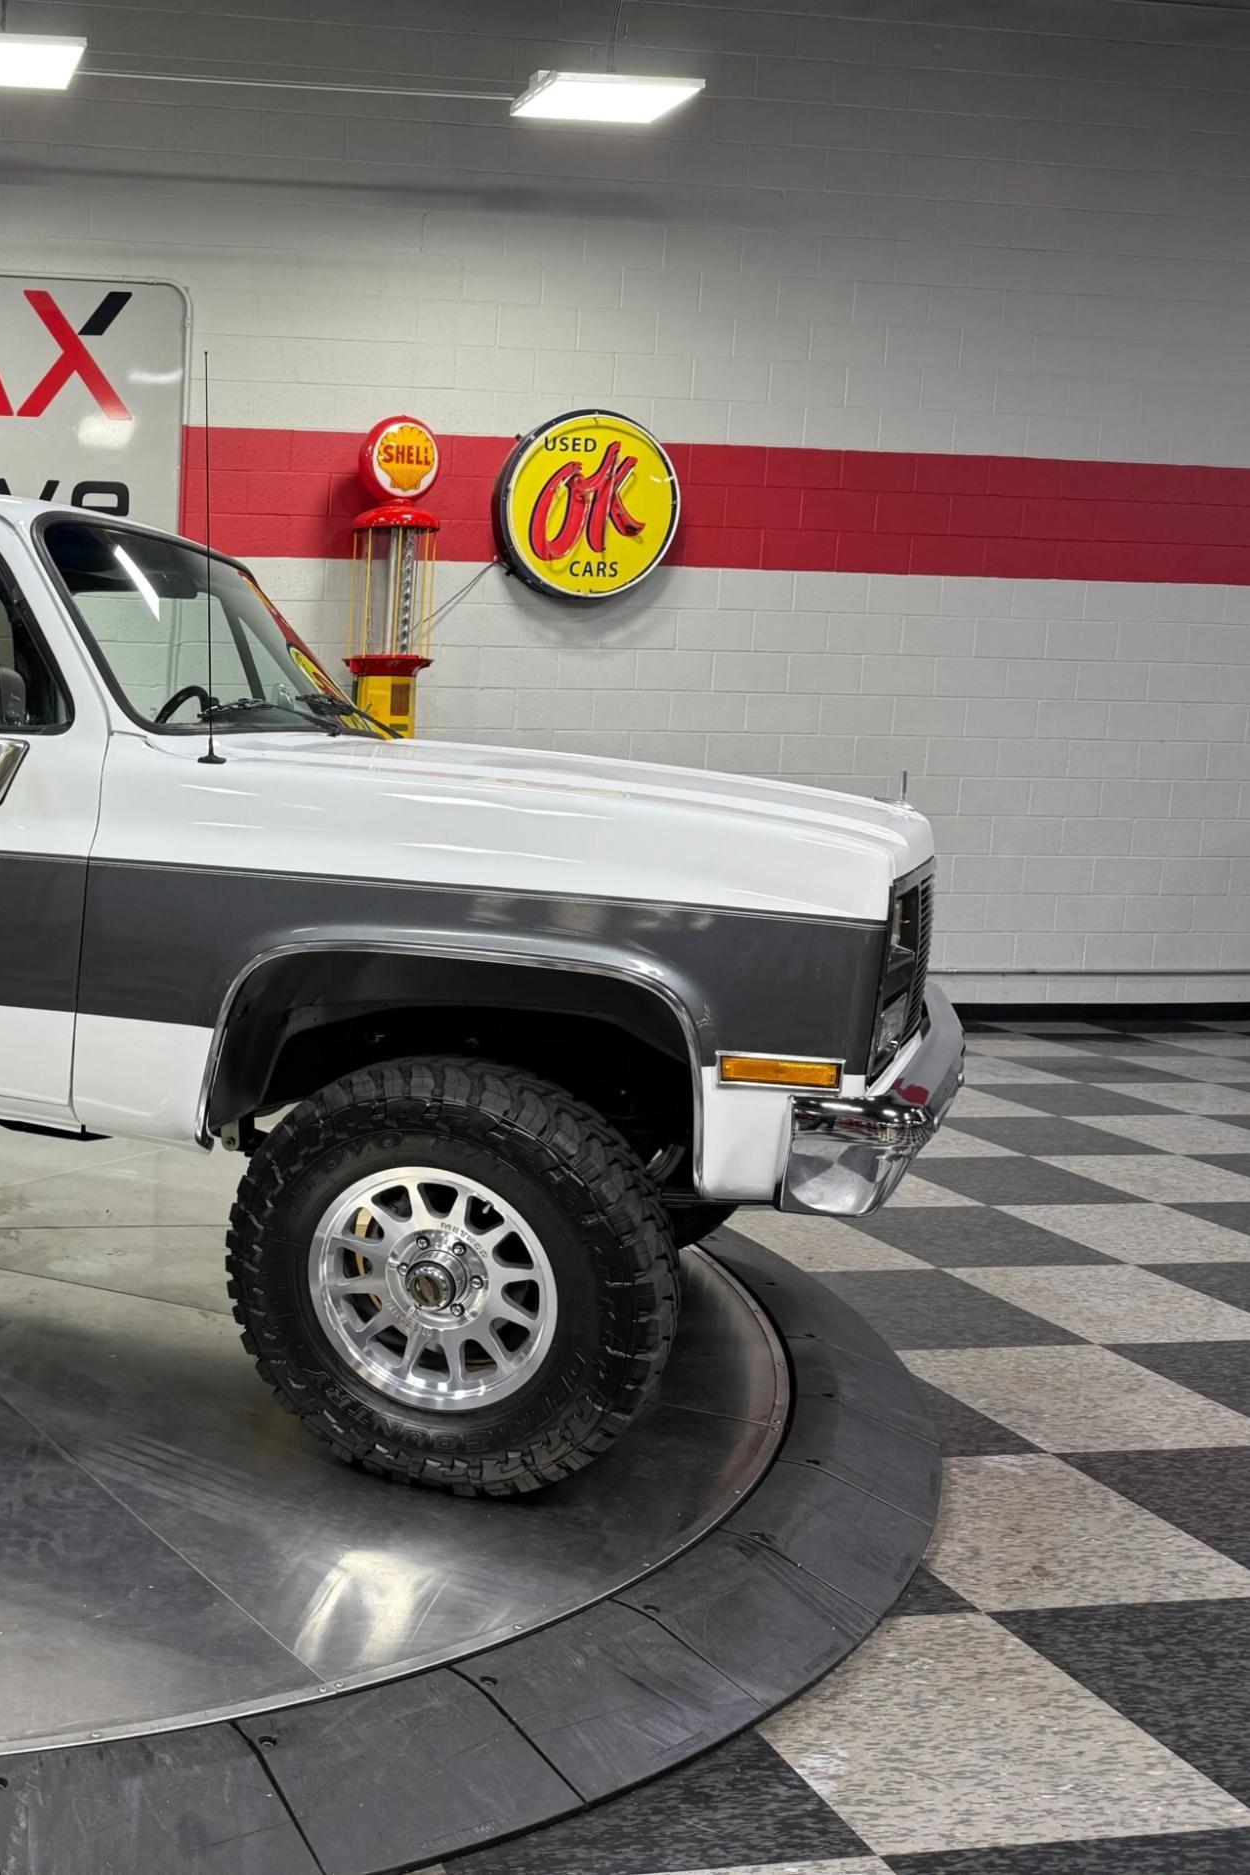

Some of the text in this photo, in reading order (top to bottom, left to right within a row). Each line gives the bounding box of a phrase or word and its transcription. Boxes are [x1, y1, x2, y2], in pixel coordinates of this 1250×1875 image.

[544, 436, 597, 452] USED
[382, 443, 431, 466] SHELL
[529, 440, 646, 561] OK
[569, 561, 618, 577] CARS
